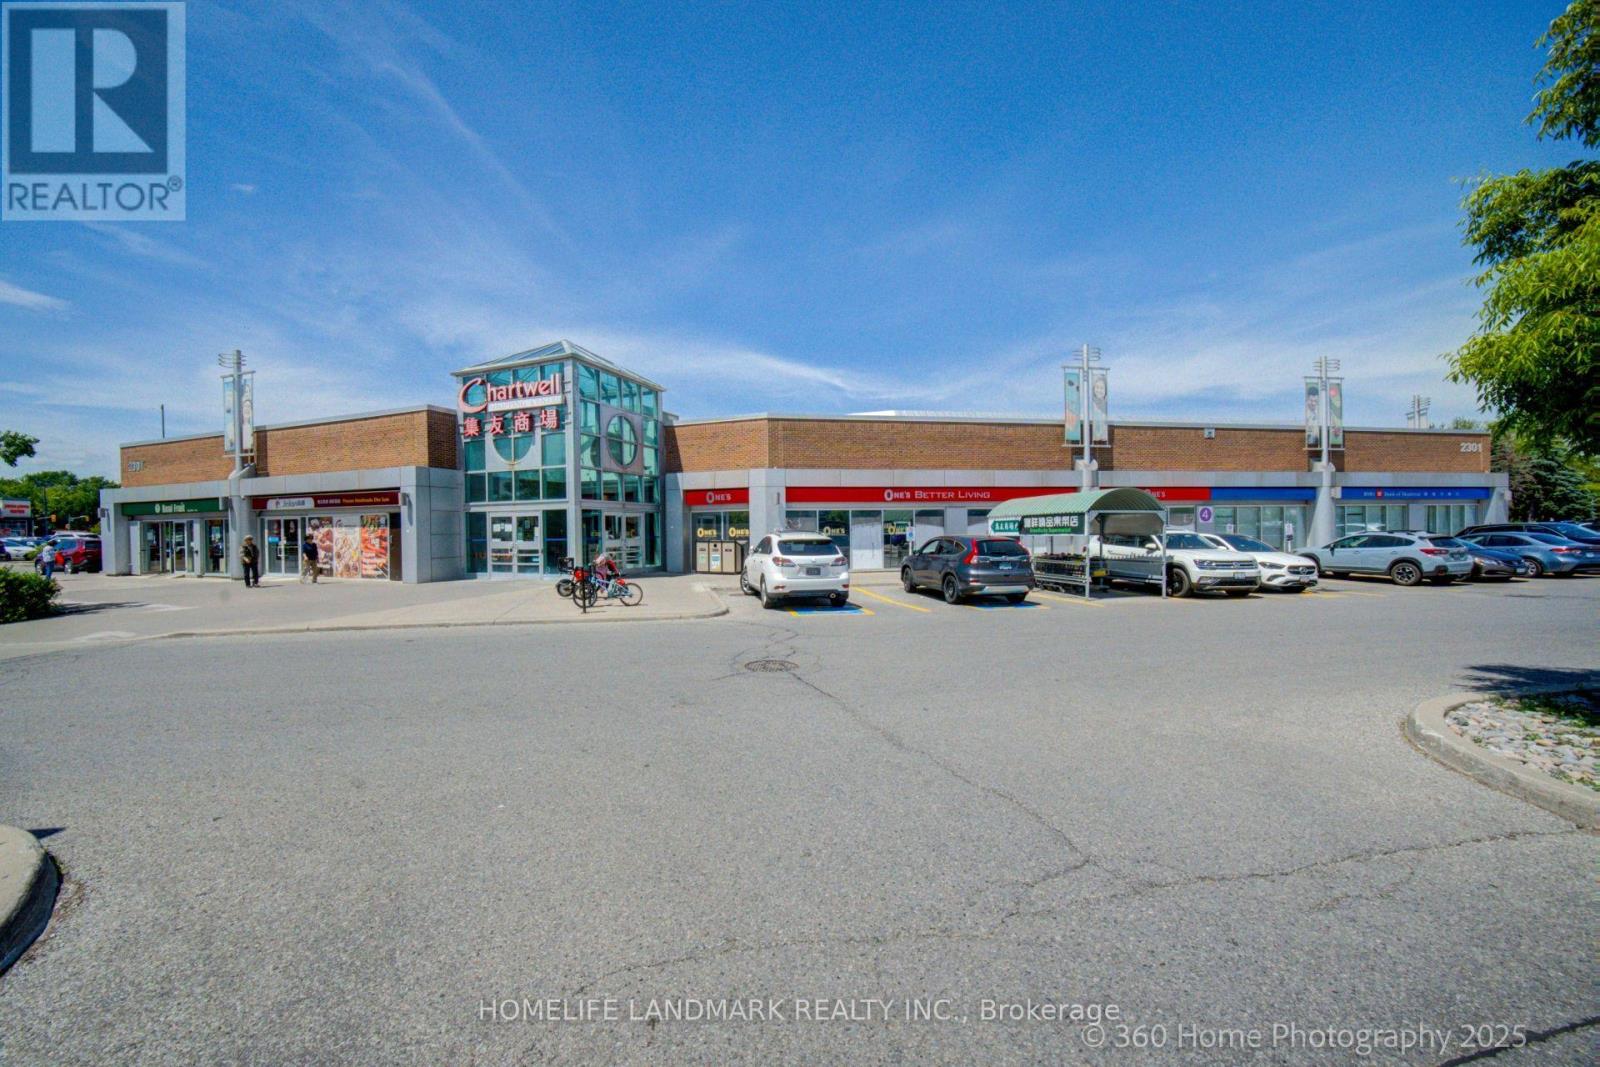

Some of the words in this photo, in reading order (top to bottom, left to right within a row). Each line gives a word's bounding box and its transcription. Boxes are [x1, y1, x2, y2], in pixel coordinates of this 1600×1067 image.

[458, 372, 561, 413] Chartwell
[463, 409, 558, 437] 集友商場
[914, 490, 955, 499] BETTER
[958, 490, 990, 499] LIVING
